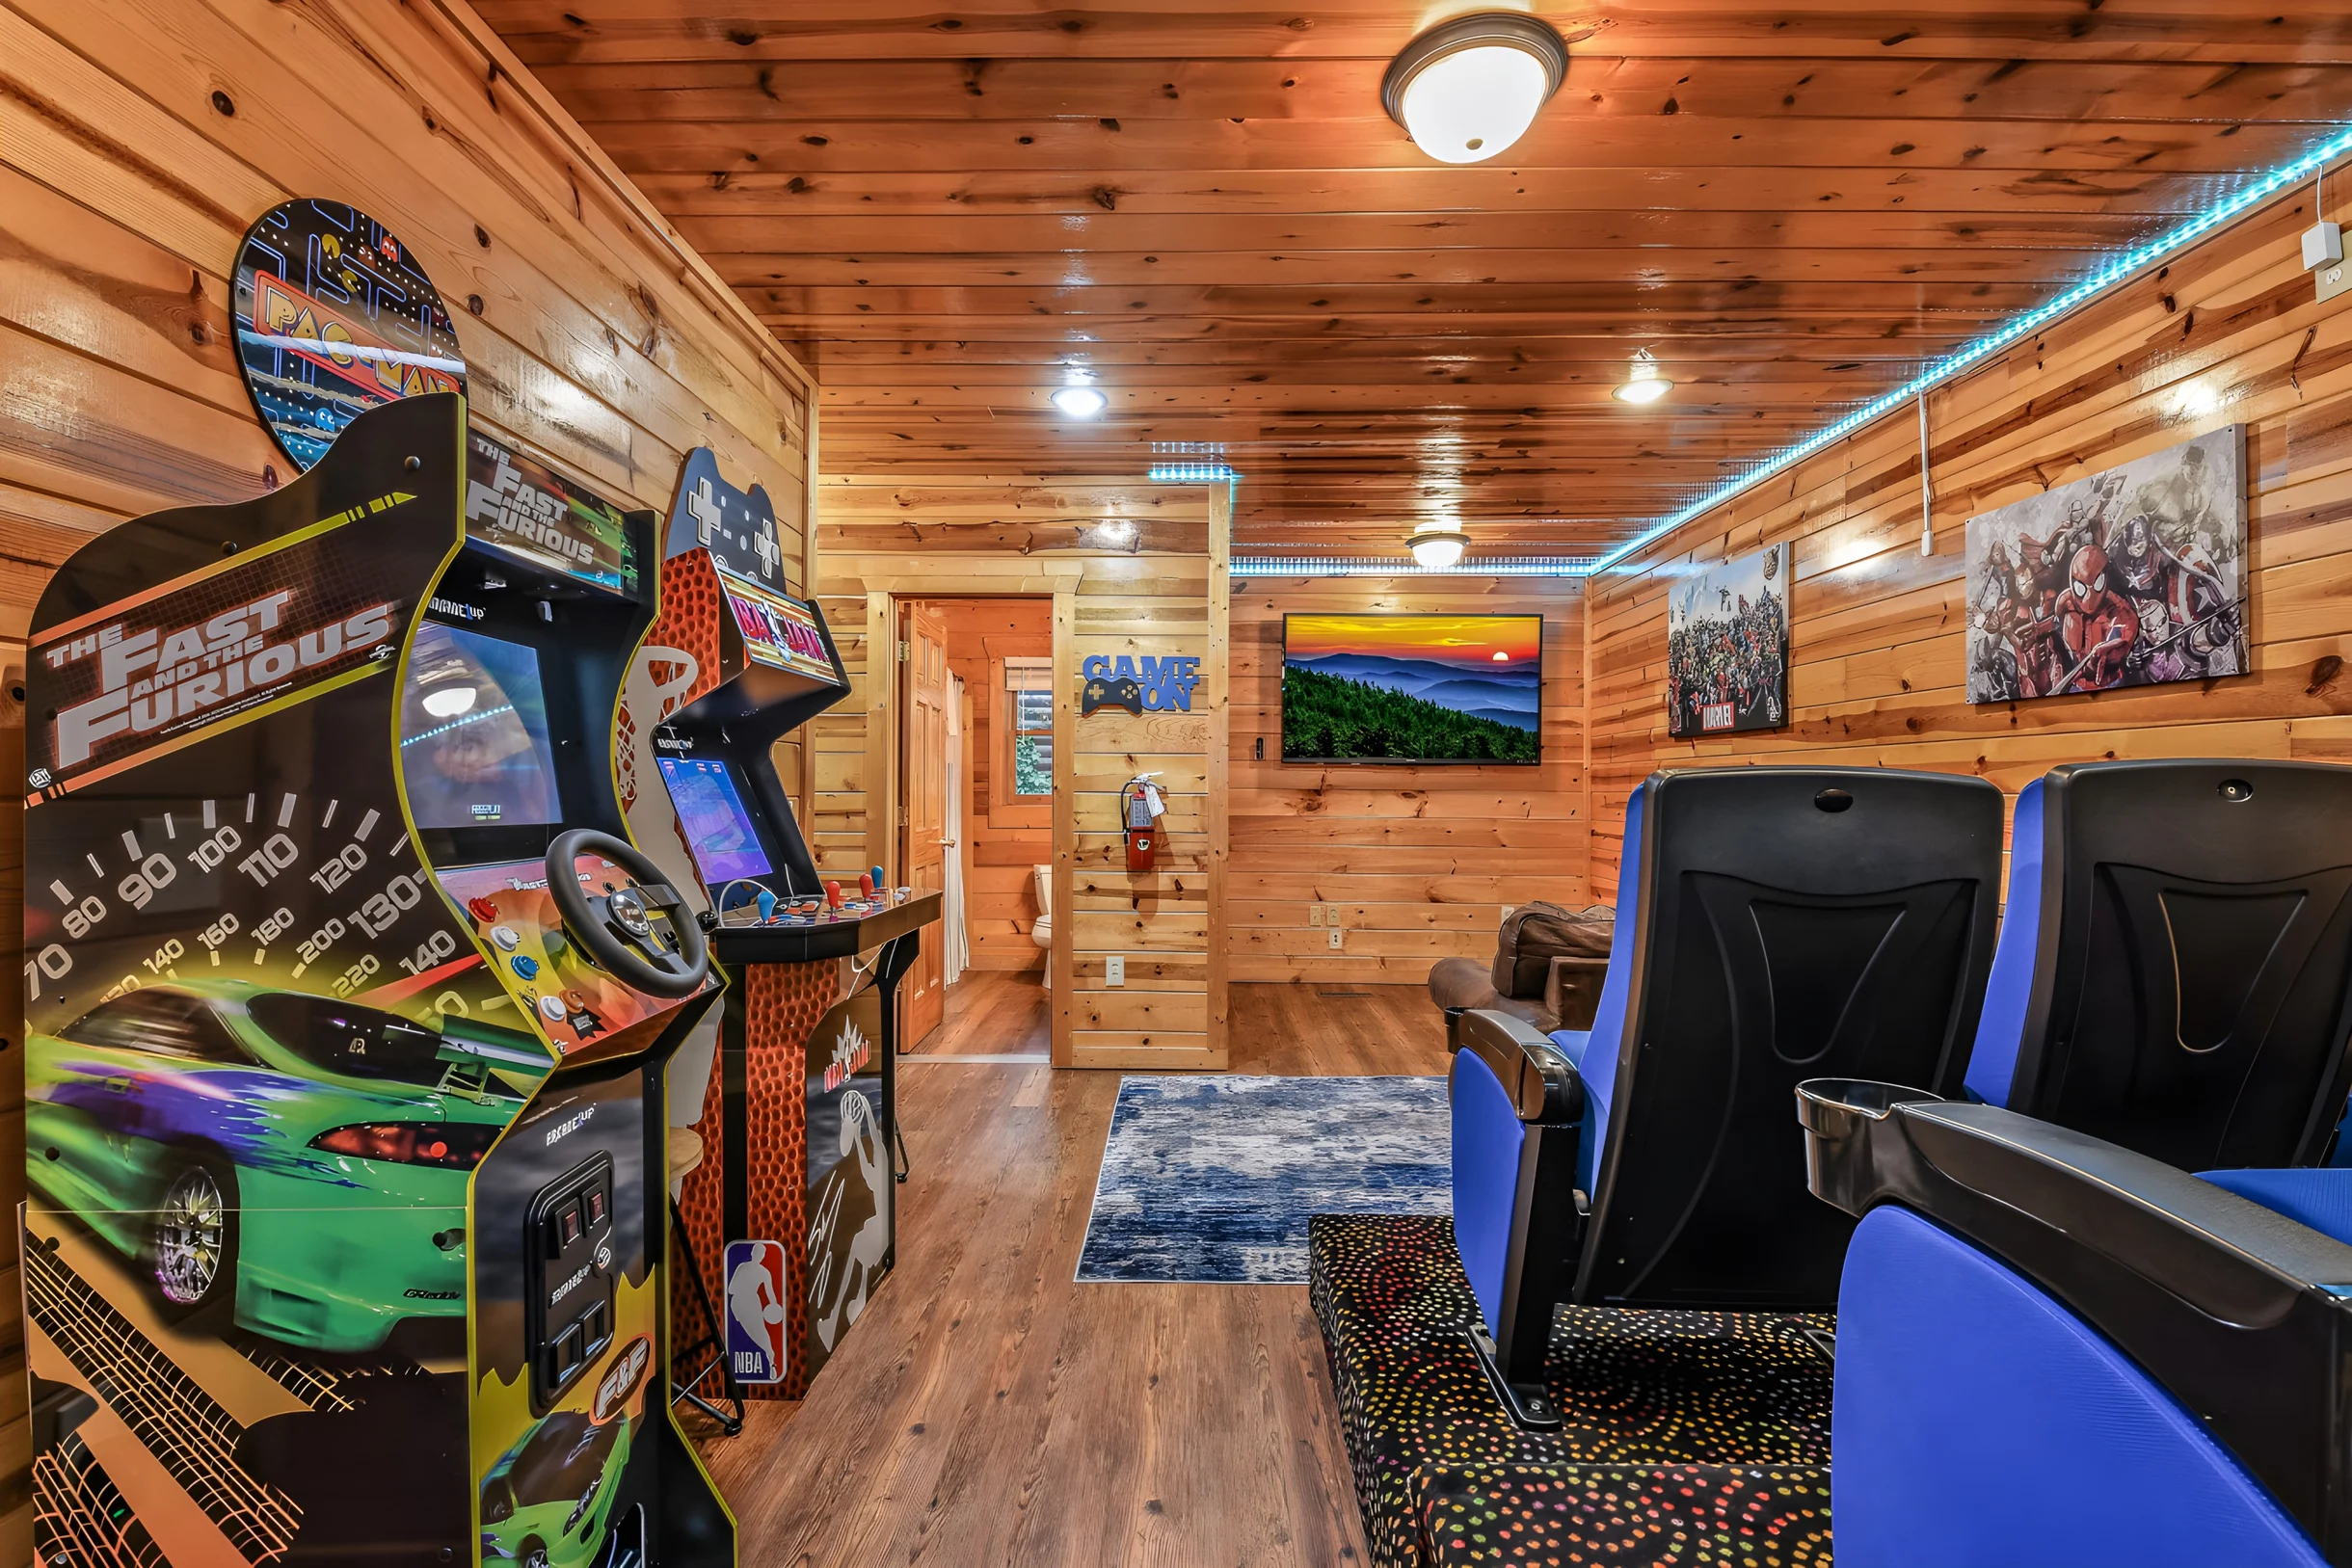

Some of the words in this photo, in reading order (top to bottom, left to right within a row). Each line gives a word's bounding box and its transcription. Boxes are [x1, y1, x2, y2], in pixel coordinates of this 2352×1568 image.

[476, 438, 512, 466] THE
[493, 462, 569, 521] FAST
[466, 480, 595, 565] FURIOUS
[46, 623, 123, 668] THE
[100, 591, 290, 694] FAST
[57, 603, 391, 769] FURIOUS
[130, 657, 192, 701] AND
[203, 634, 263, 670] THE
[1082, 654, 1200, 684] GAME
[1139, 683, 1195, 711] ON
[187, 826, 243, 873] 100
[237, 833, 299, 888] 110
[309, 843, 368, 894] 120
[118, 852, 177, 911] 90
[62, 895, 107, 940] 80
[251, 907, 295, 946] 180
[347, 875, 422, 940] 130
[197, 913, 240, 950] 160
[296, 917, 346, 964] 200
[398, 929, 456, 975] 140
[143, 938, 185, 974] 140
[332, 953, 381, 998] 220
[596, 1336, 649, 1421] F&F
[734, 1350, 764, 1375] NBA
